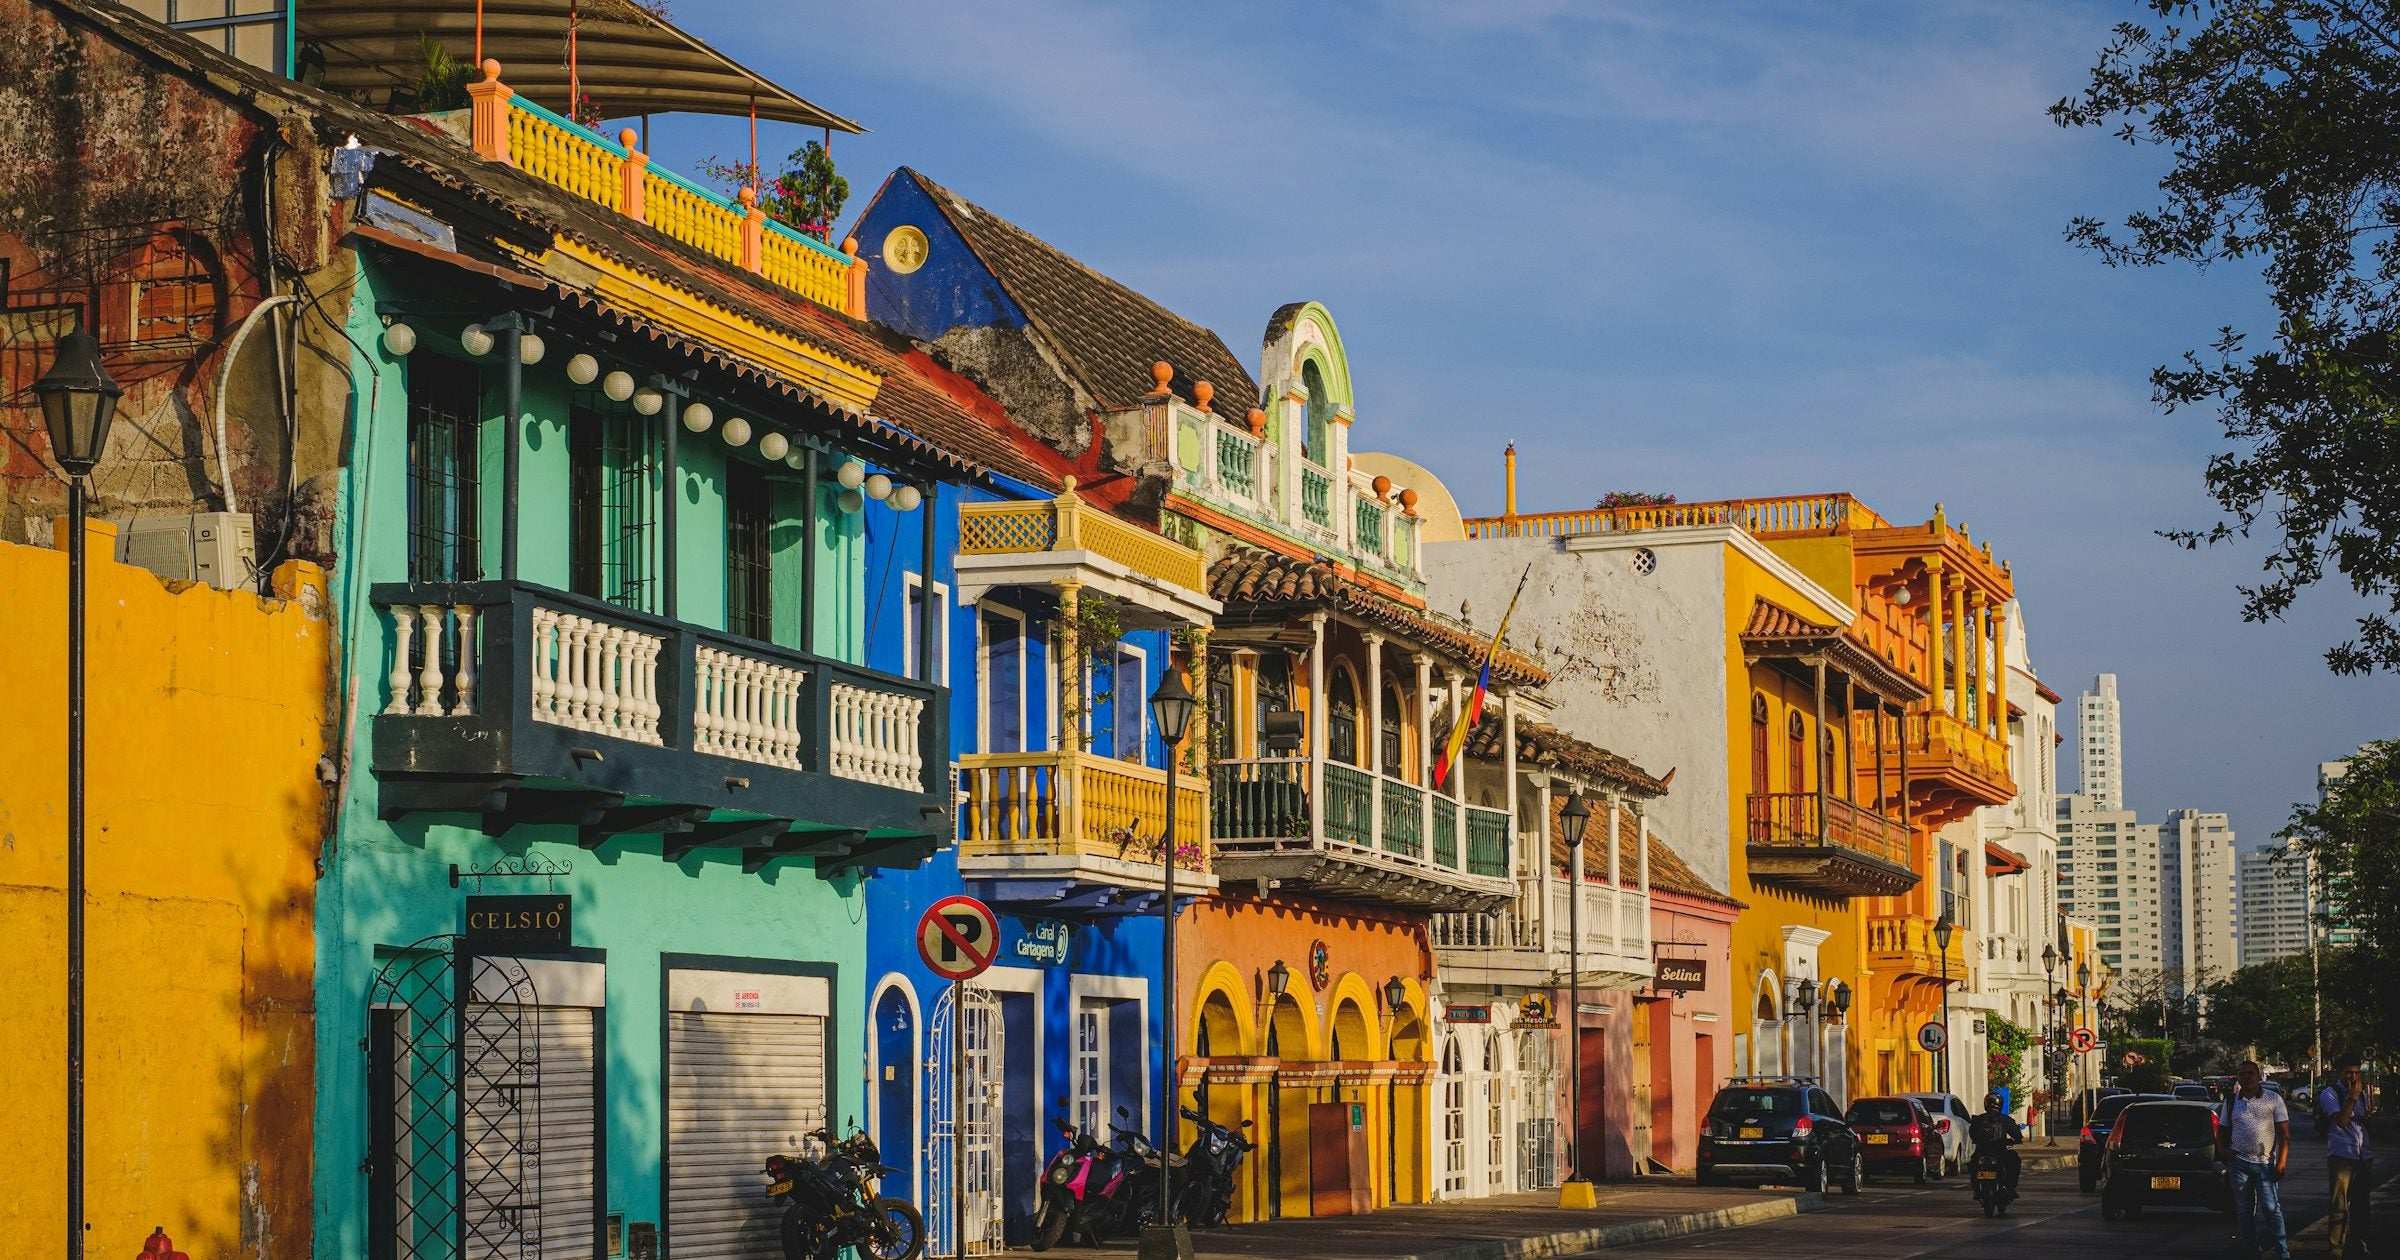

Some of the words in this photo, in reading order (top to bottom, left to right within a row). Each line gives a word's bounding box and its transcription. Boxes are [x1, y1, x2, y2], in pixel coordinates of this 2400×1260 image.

[941, 914, 982, 962] P
[1035, 922, 1055, 940] Canal
[1016, 938, 1055, 961] Cartagena
[1661, 966, 1702, 982] Selina
